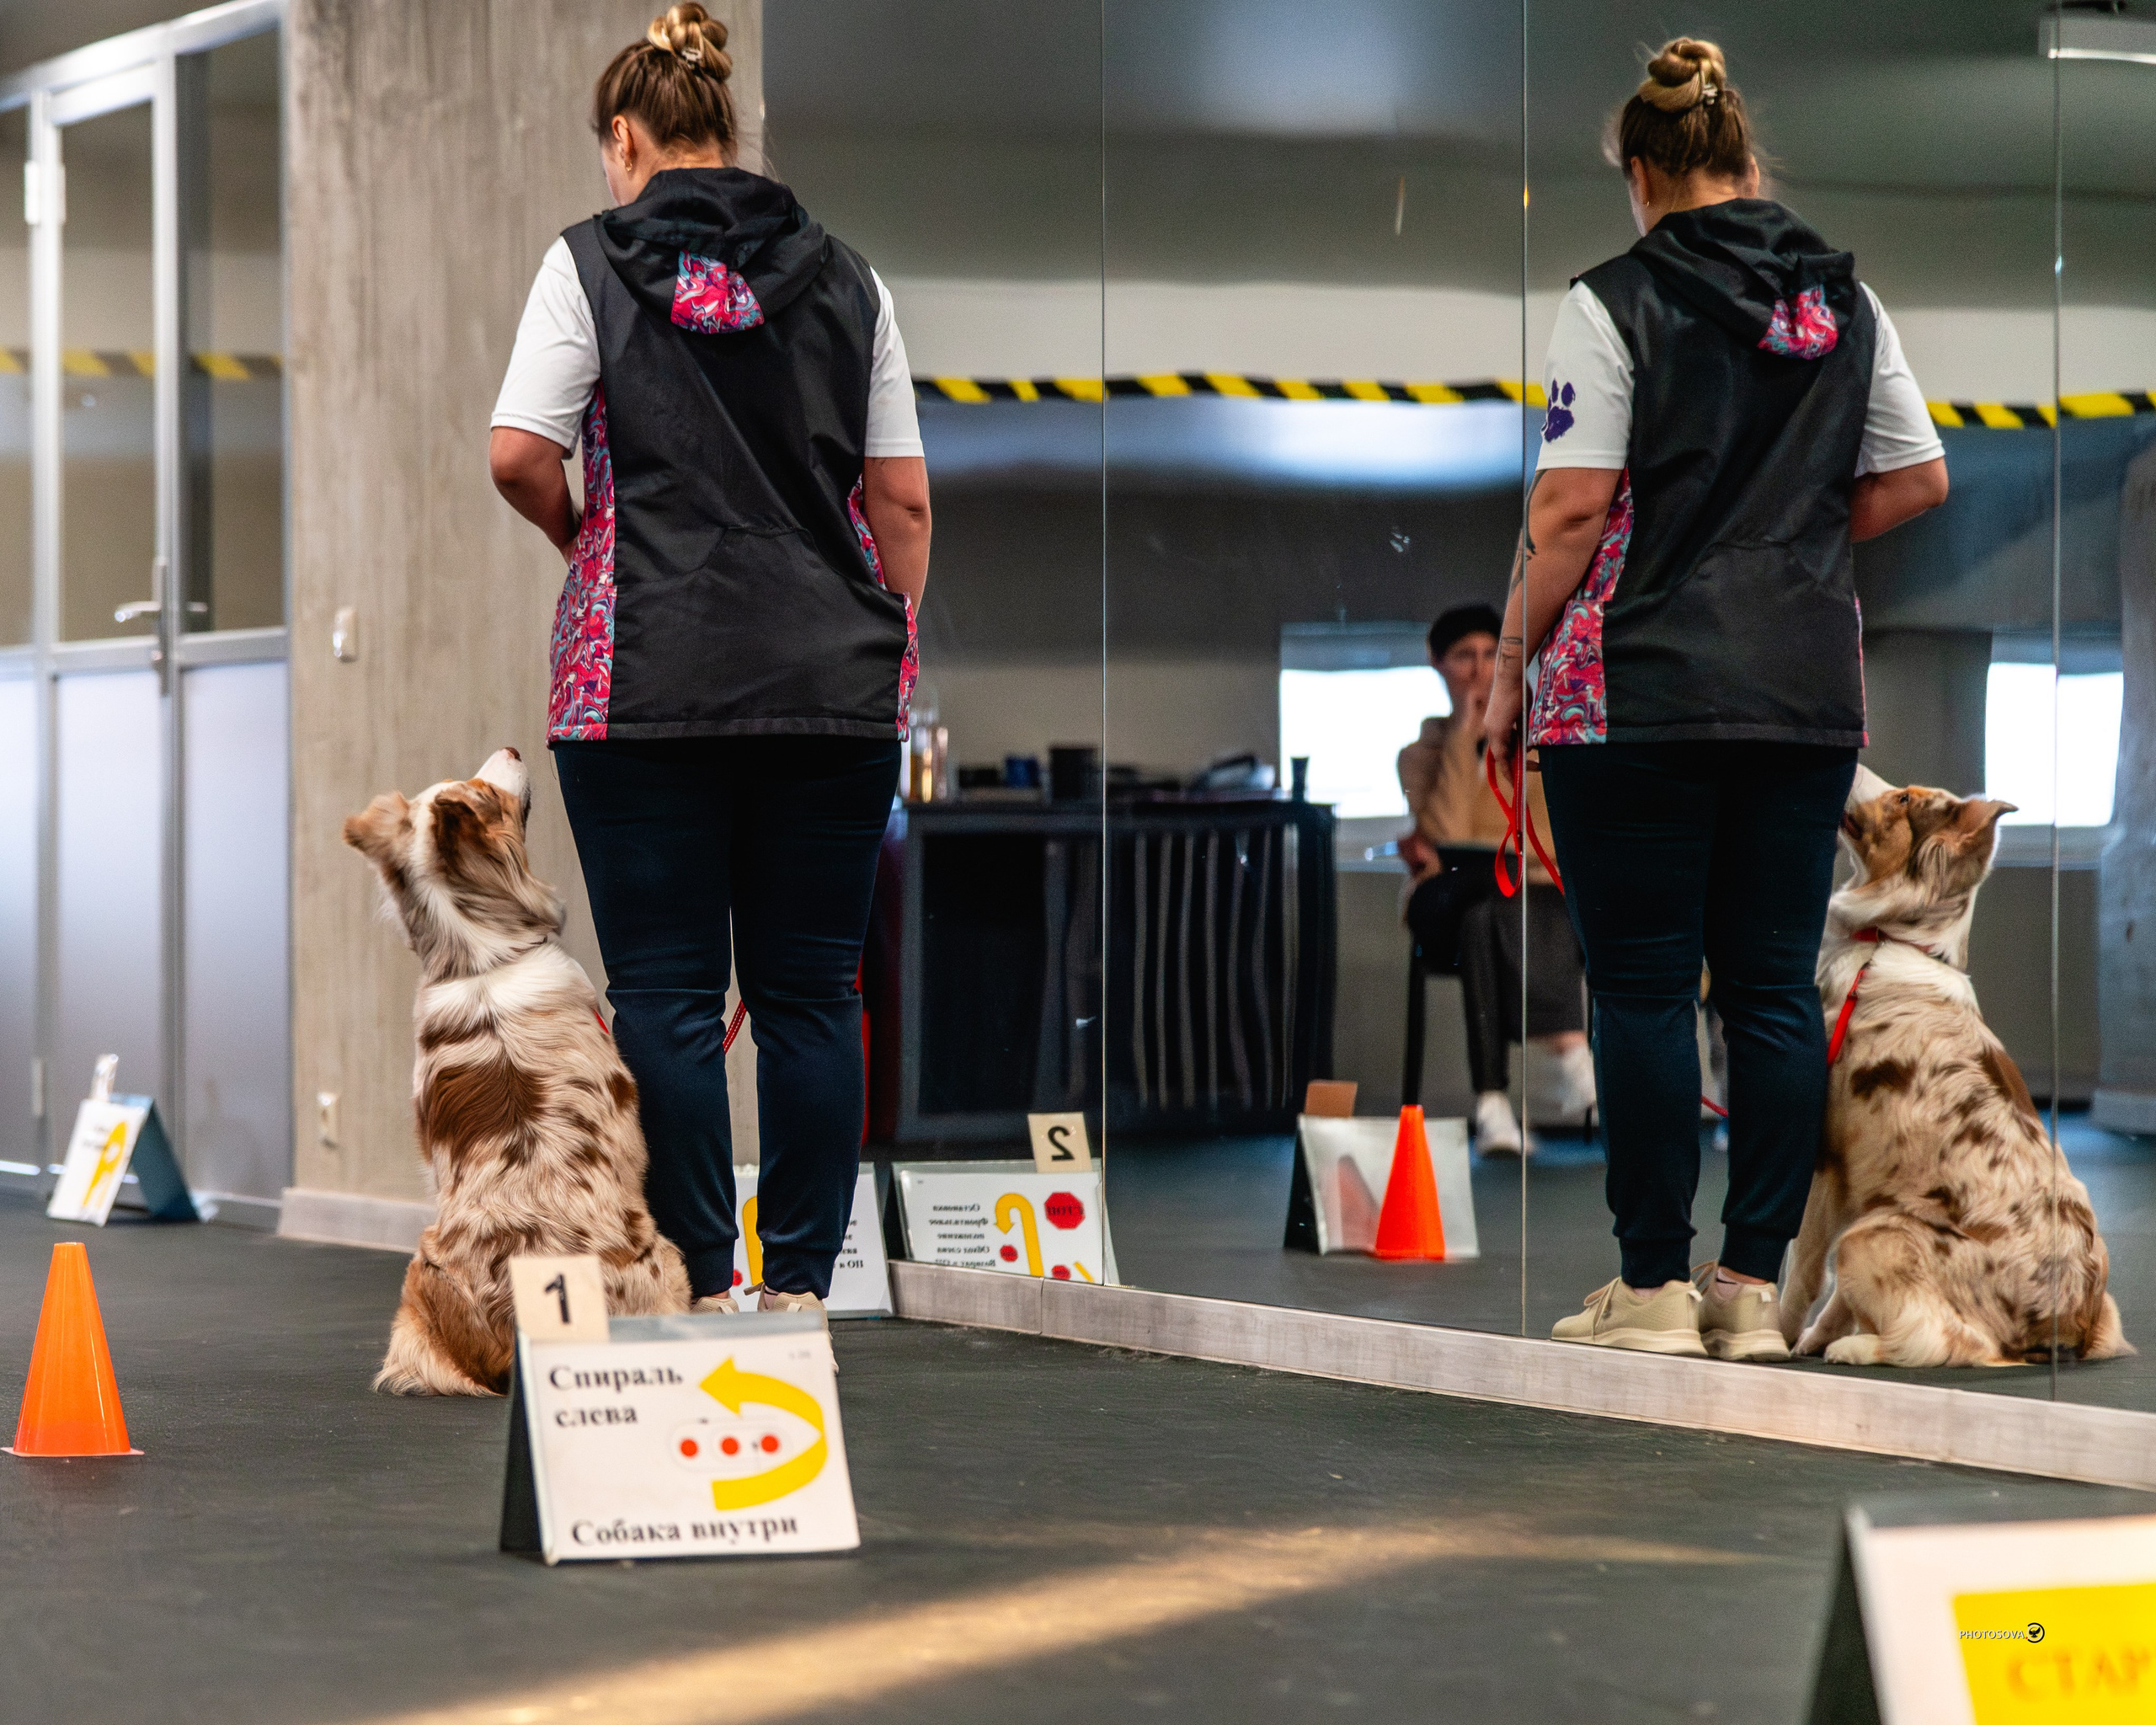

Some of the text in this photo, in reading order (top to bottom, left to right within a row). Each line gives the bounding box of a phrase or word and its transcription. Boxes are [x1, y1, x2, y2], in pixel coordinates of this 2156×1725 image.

[544, 1274, 572, 1325] 1
[549, 1364, 684, 1393] Спираль
[555, 1406, 639, 1428] слева
[571, 1516, 798, 1546] Собака внутри
[2007, 1645, 2156, 1703] СТАР
